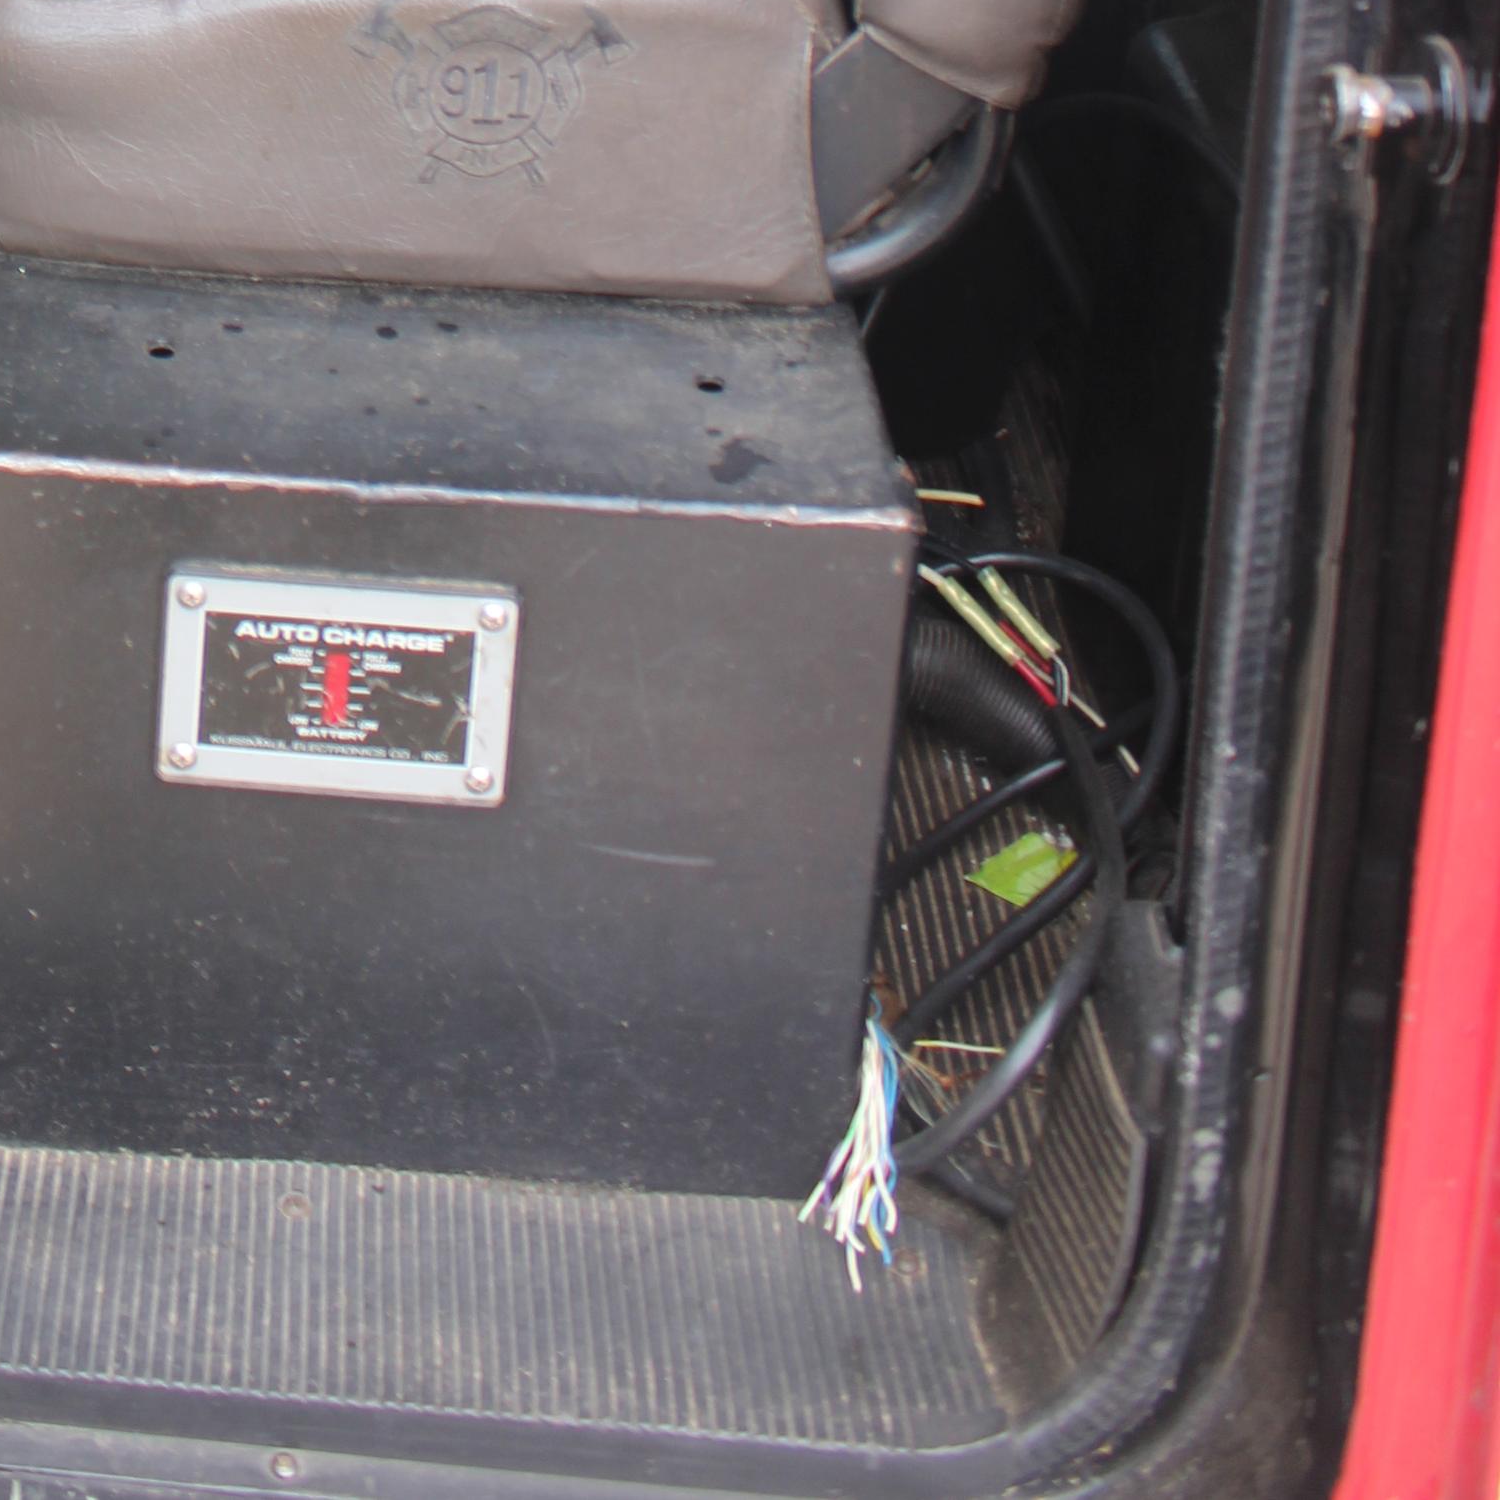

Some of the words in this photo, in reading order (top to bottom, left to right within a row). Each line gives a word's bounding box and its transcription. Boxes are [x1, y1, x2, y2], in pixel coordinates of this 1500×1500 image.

[438, 60, 531, 126] 911
[235, 620, 319, 642] AUTO
[322, 626, 444, 652] CHARGE
[296, 726, 368, 742] BATTERY
[293, 742, 387, 757] ELECTRONICS
